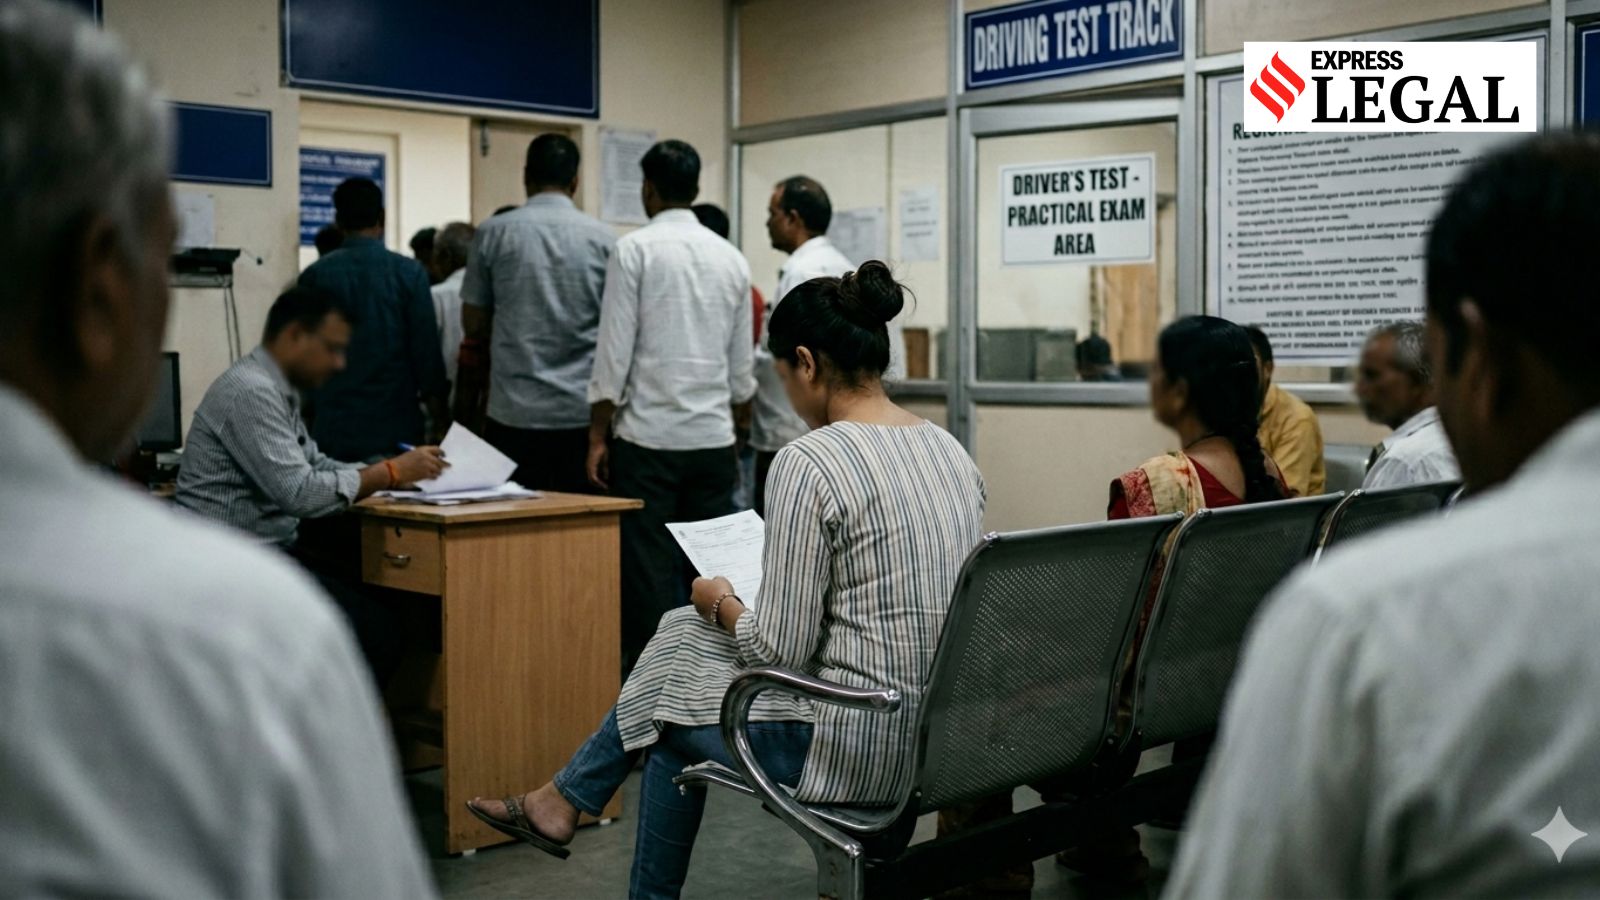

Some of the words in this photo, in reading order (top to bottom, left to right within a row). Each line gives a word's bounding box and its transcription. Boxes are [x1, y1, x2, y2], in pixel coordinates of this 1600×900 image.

[974, 14, 1049, 73] DRIVING
[1054, 6, 1102, 60] TEST
[1106, 0, 1175, 51] TRACK
[1013, 170, 1085, 196] DRIVER'S
[1089, 166, 1129, 190] TEST
[1008, 201, 1095, 227] PRACTICAL
[1100, 197, 1146, 222] EXAM
[1054, 232, 1096, 255] AREA
